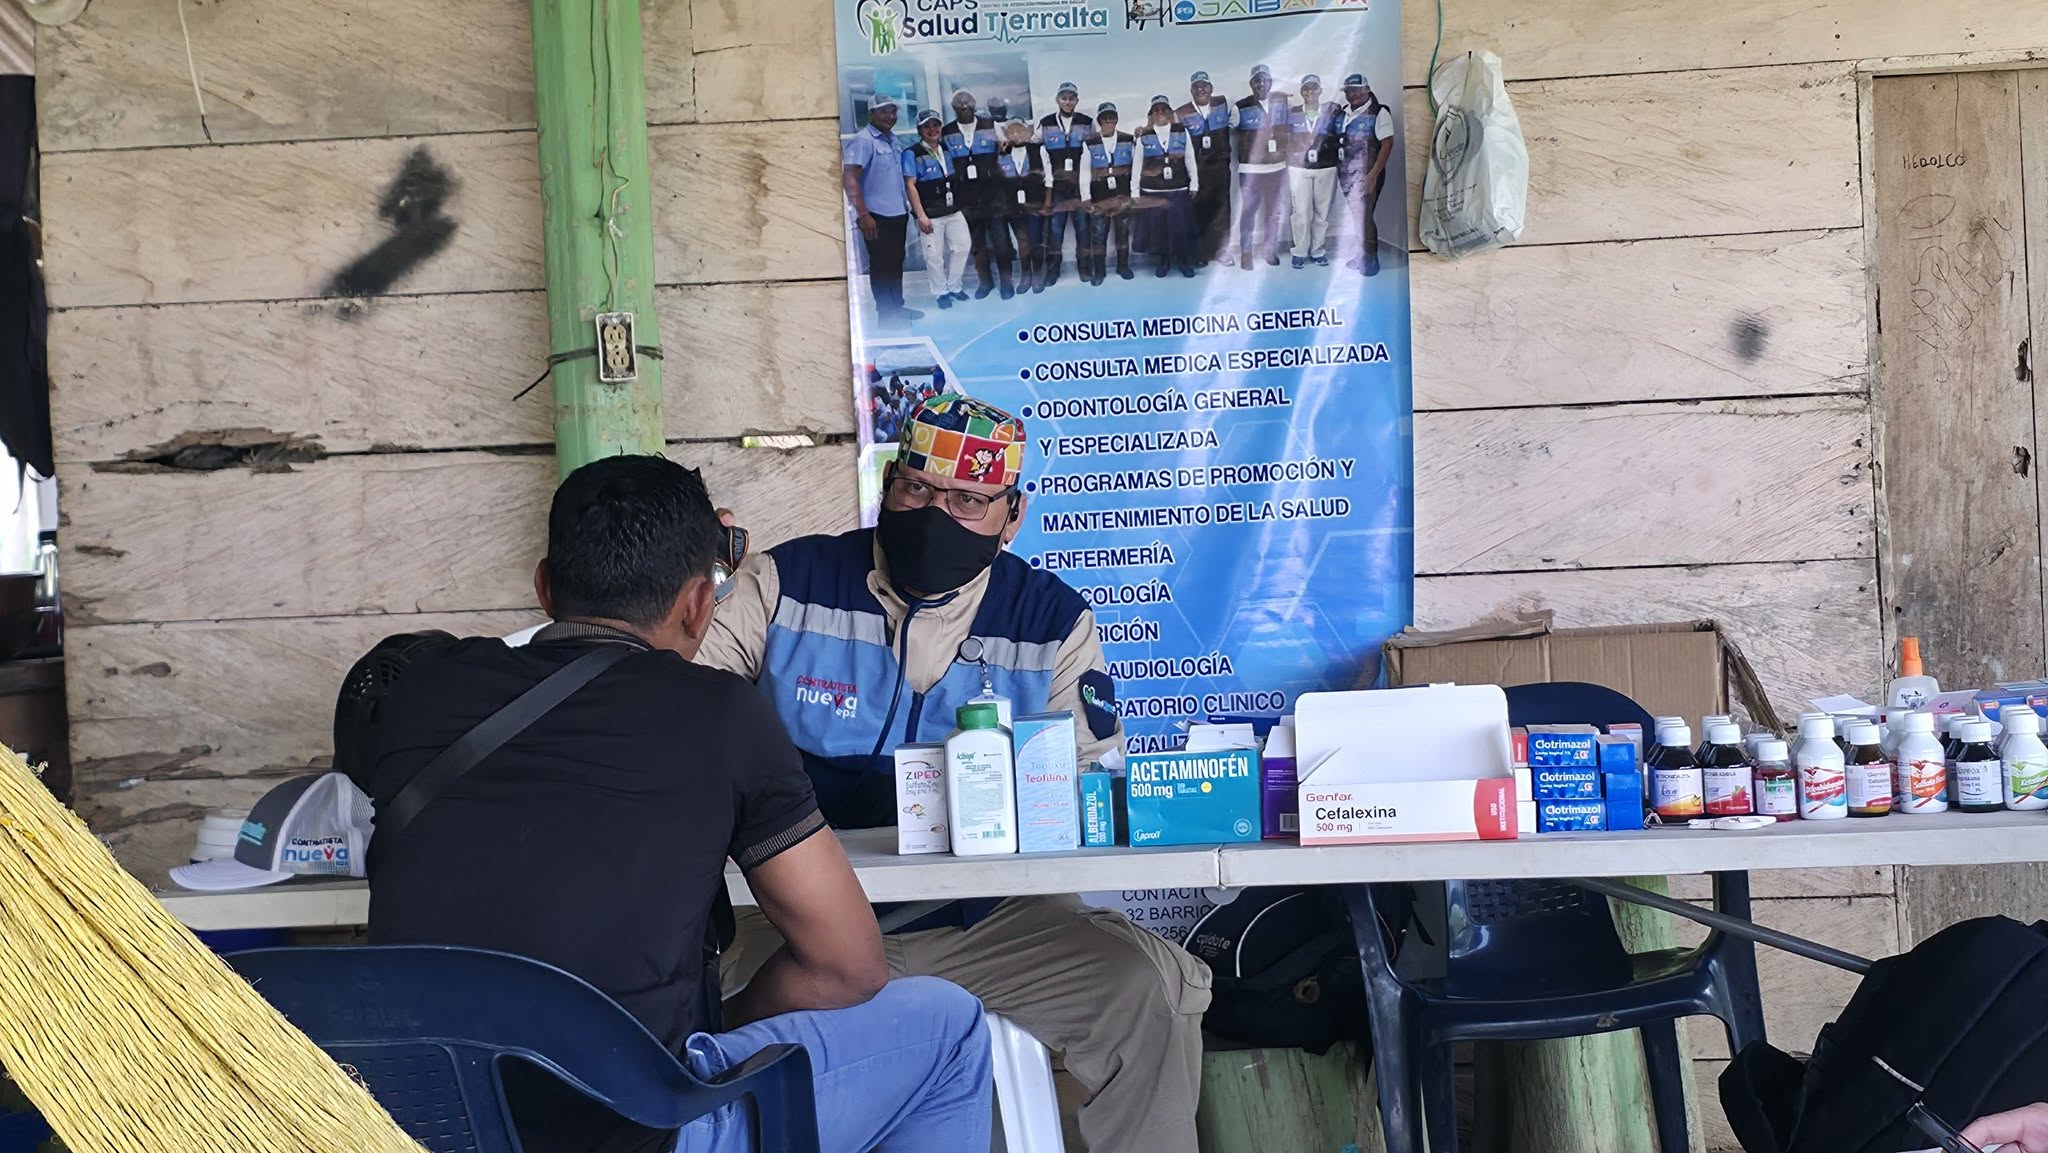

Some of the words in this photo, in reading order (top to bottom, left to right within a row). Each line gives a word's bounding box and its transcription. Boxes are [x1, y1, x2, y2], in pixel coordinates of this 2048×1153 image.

[917, 0, 978, 11] CAPS
[902, 12, 978, 37] Salud
[984, 8, 1108, 33] Tierralta
[1033, 321, 1137, 343] CONSULTA
[1143, 315, 1240, 337] MEDICINA
[1247, 308, 1343, 331] GENERAL
[1035, 359, 1138, 381] CONSULTA
[1144, 354, 1222, 376] MEDICA
[1228, 344, 1389, 370] ESPECIALIZADA
[1037, 389, 1187, 419] ODONTOLOGÍA
[1194, 387, 1291, 410] GENERAL
[1039, 439, 1052, 456] Y
[1059, 430, 1218, 456] ESPECIALIZADA
[1041, 471, 1172, 494] PROGRAMAS
[1177, 469, 1205, 487] DE
[1210, 457, 1335, 484] PROMOCIÓN
[1340, 461, 1354, 478] Y
[1043, 506, 1210, 532] MANTENIMIENTO
[1216, 504, 1243, 522] DE
[1249, 503, 1276, 520] LA
[1281, 499, 1349, 519] SALUD
[1046, 545, 1173, 570] ENFERMERÍA
[1082, 579, 1171, 605] COLOGÍA
[1100, 620, 1159, 643] RICIÓN
[1106, 653, 1232, 680] AUDIOLOGÍA
[796, 687, 858, 710] nueva
[1115, 697, 1198, 718] RATORIO
[1204, 692, 1285, 714] CLINICO
[835, 708, 857, 719] eps
[1535, 739, 1591, 749] Clotrimazol
[905, 769, 942, 781] ZIPED
[1025, 773, 1067, 783] Teofilina
[1130, 753, 1249, 782] ACETAMINOFÉN
[1540, 772, 1595, 782] Clotrimazol
[1153, 785, 1174, 799] mg
[1306, 793, 1352, 802] Genfar
[1086, 790, 1099, 843] ALBENDAZOL
[1316, 806, 1397, 821] Cefalexina
[1545, 804, 1601, 815] Clotrimazol
[1316, 823, 1334, 832] 500
[1336, 823, 1353, 832] mg
[284, 846, 349, 861] nueva
